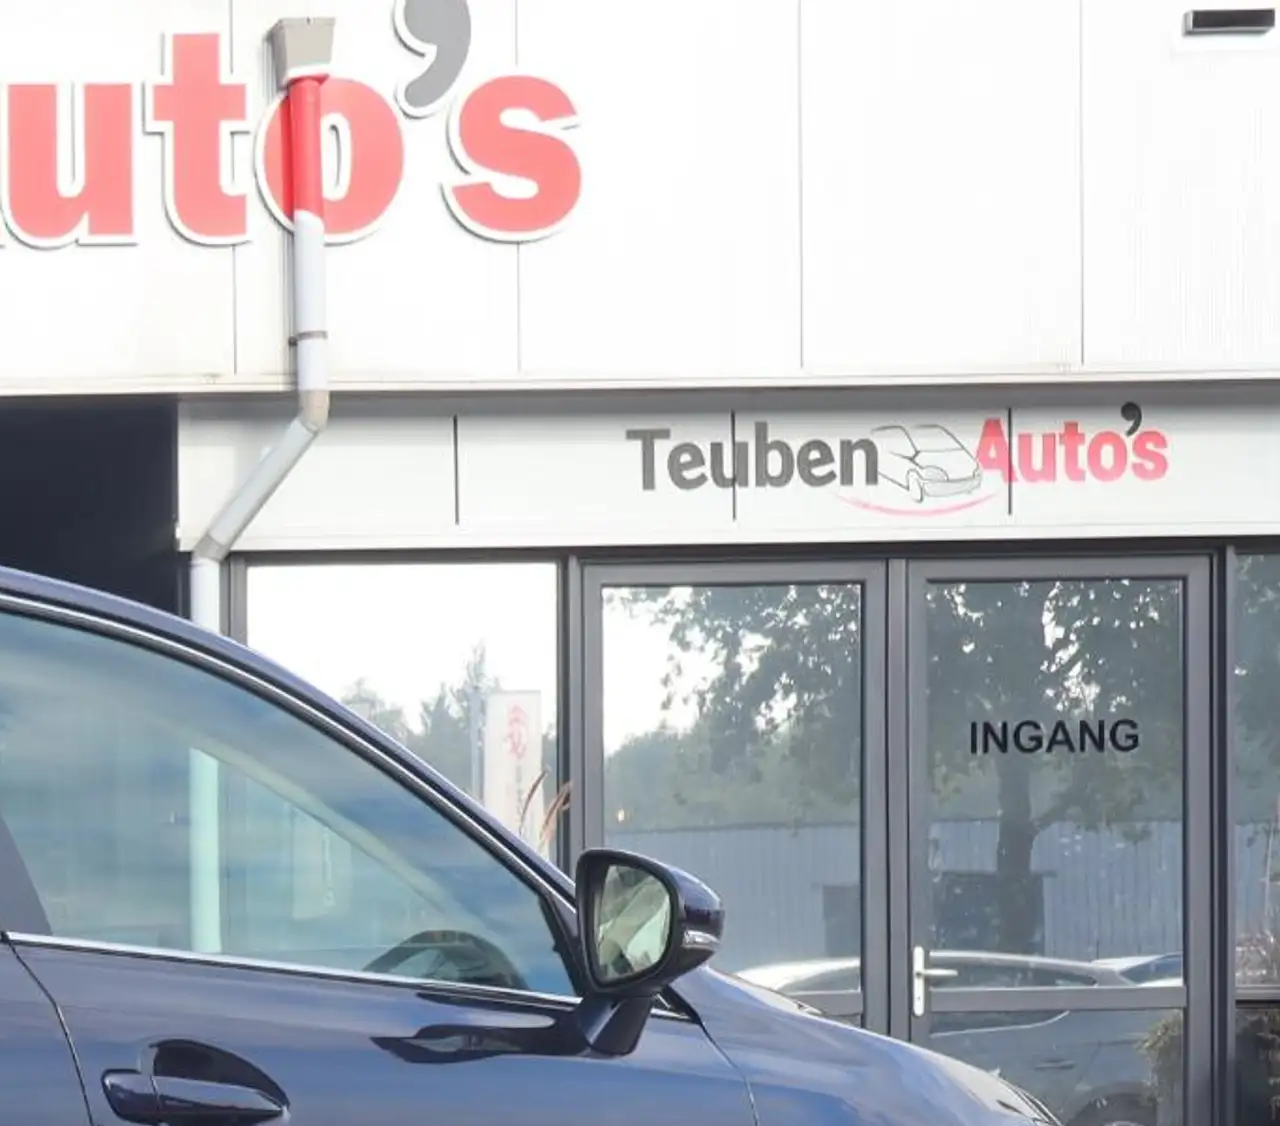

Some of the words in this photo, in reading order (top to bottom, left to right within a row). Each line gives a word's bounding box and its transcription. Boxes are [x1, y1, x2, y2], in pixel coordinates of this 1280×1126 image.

[626, 421, 879, 491] Teuben
[974, 402, 1169, 484] Auto's
[970, 718, 1140, 756] INGANG
